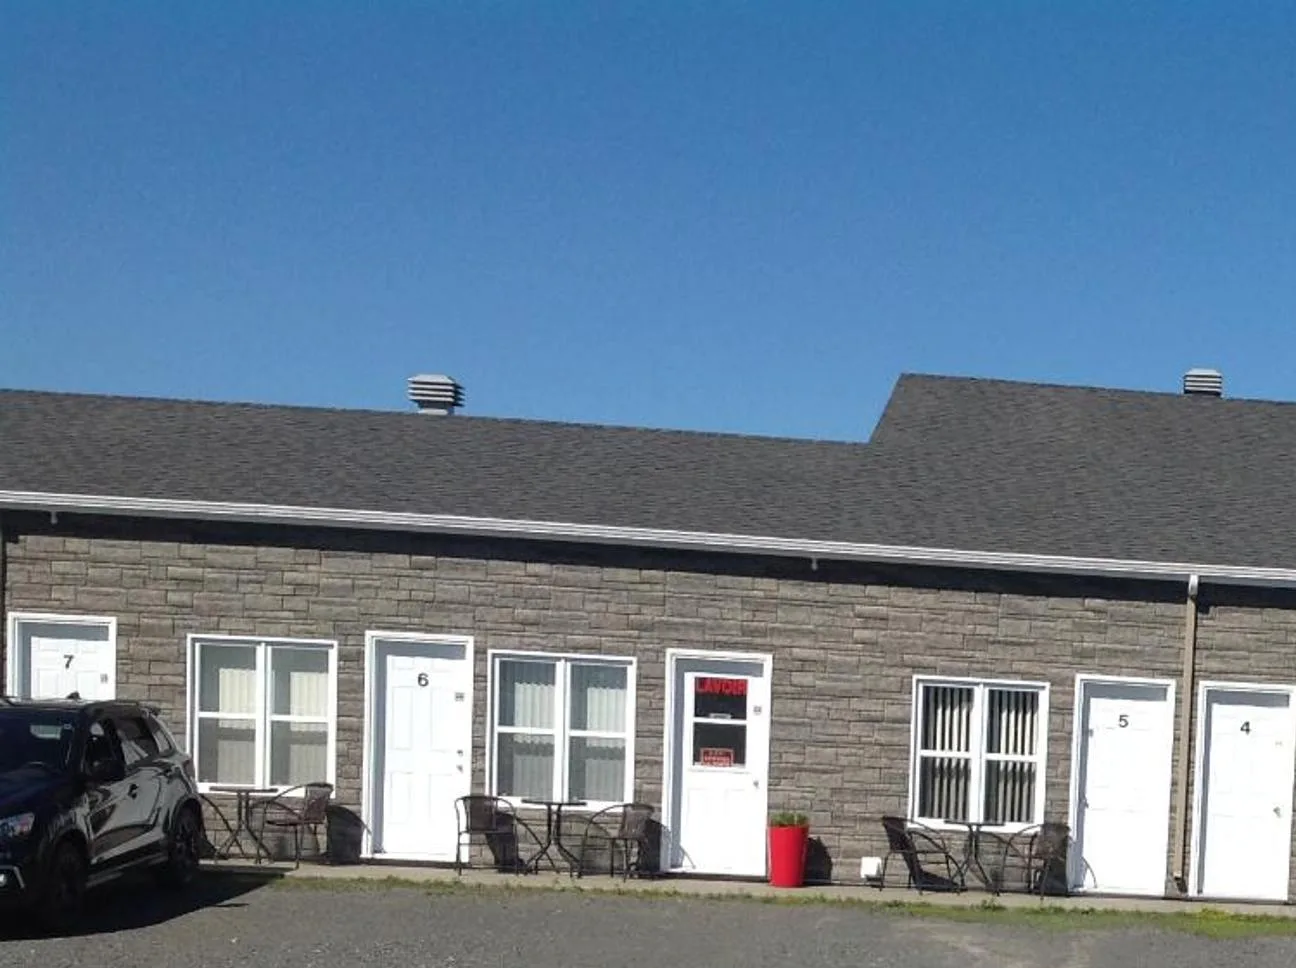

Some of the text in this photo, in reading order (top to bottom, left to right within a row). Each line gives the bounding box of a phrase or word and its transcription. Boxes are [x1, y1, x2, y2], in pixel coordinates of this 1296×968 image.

[63, 654, 74, 669] 7
[417, 672, 429, 687] 6
[1118, 714, 1129, 728] 5
[1240, 721, 1251, 735] 4
